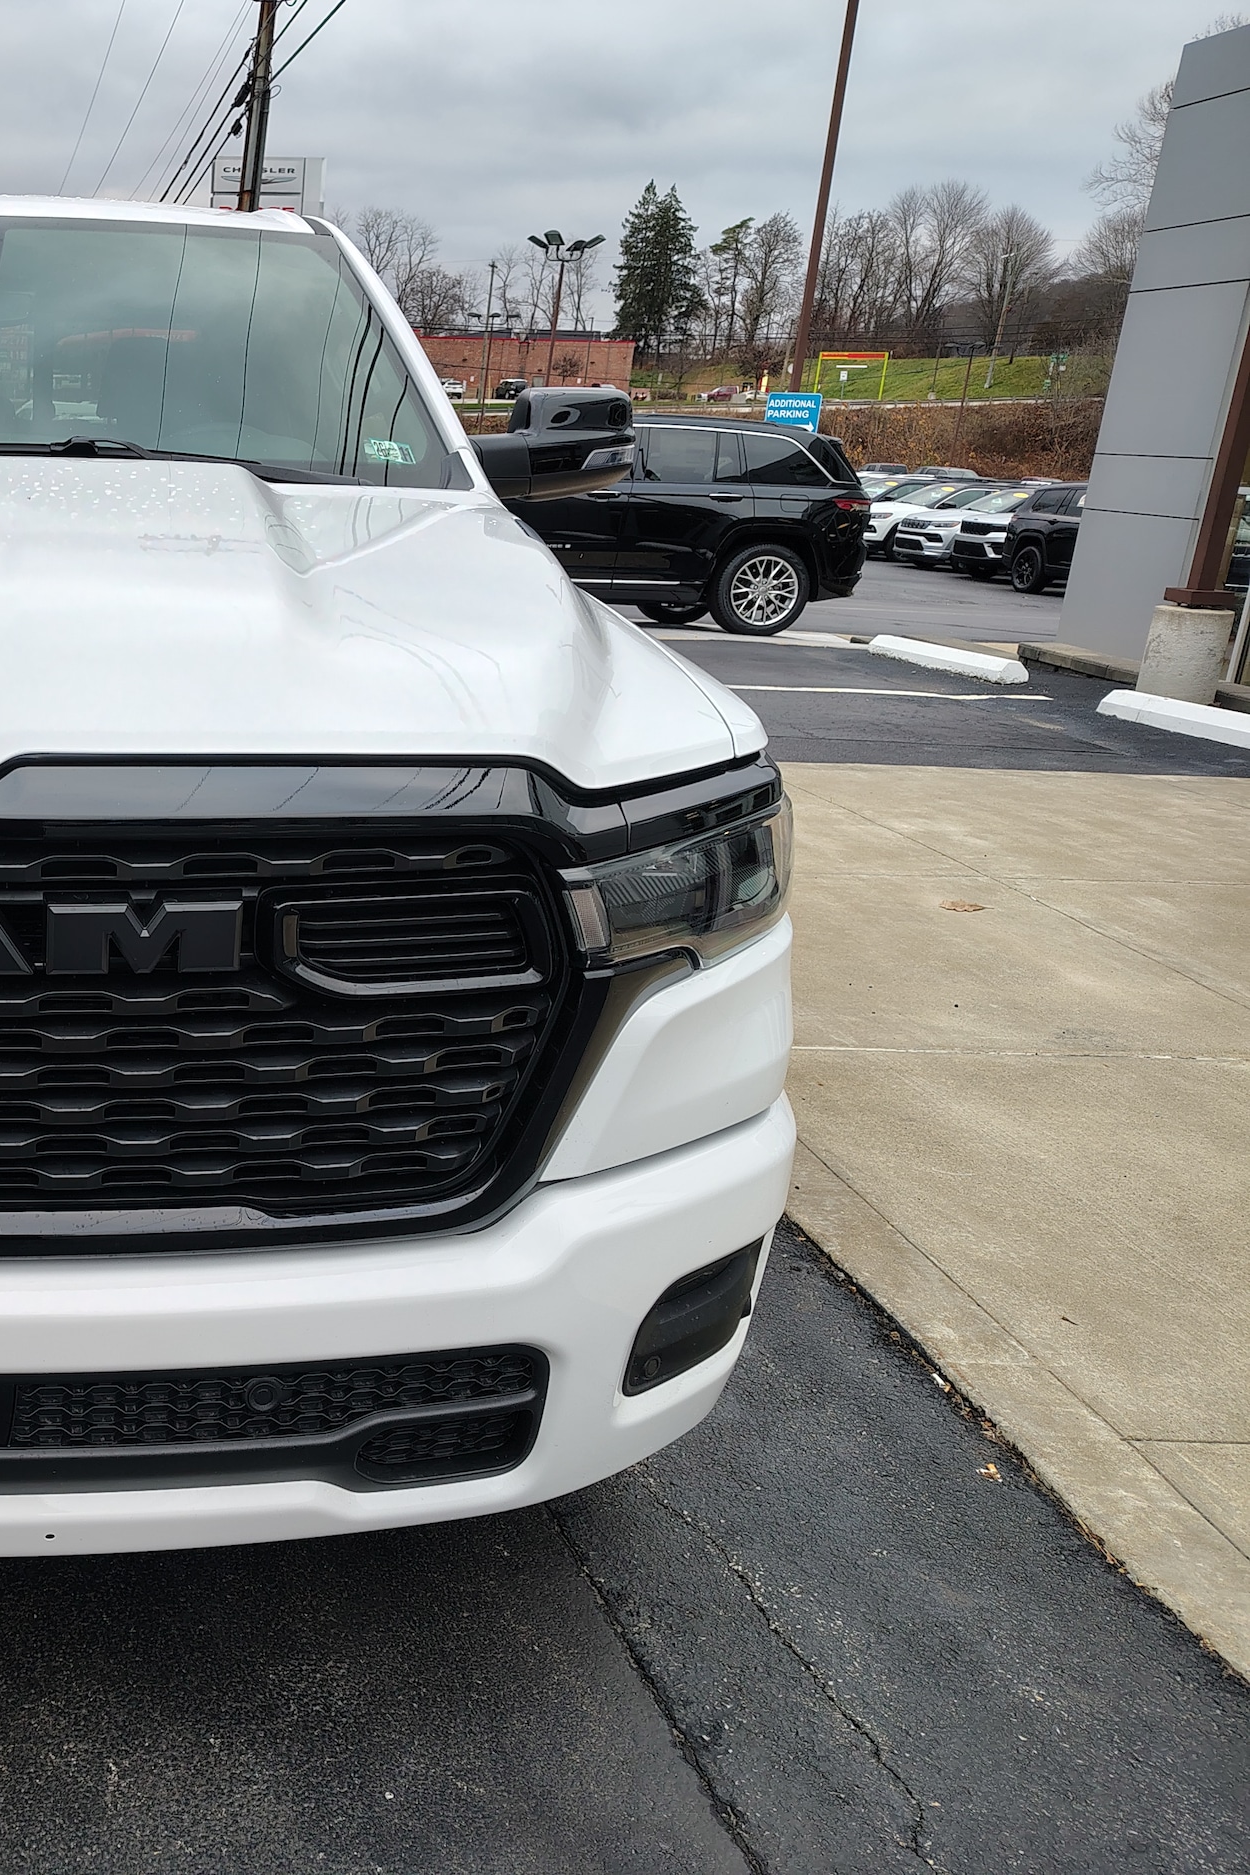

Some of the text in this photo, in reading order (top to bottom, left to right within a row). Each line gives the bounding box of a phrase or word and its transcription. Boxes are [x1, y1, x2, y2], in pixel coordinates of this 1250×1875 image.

[223, 166, 296, 174] CHSLER
[768, 399, 817, 409] ADDITIONAL
[767, 409, 810, 419] PARKING
